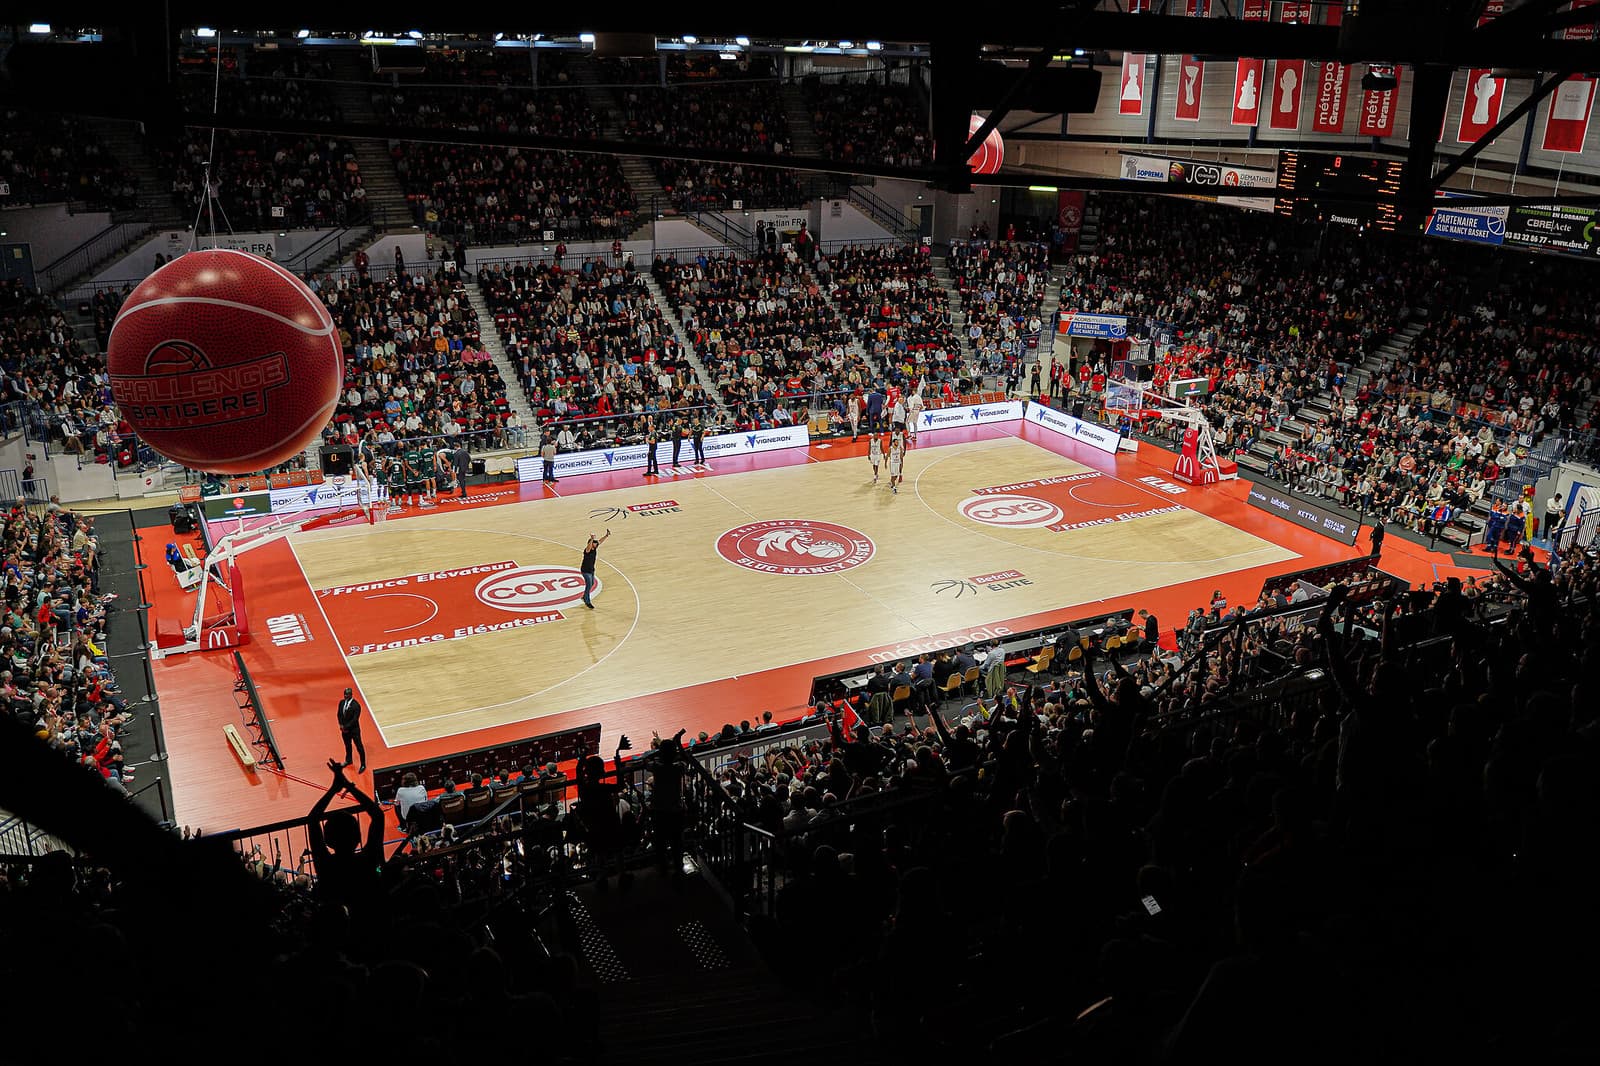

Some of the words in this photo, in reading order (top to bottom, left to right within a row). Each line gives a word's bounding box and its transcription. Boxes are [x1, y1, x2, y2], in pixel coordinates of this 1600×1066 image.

[1137, 169, 1163, 178] SOPREMA
[1185, 164, 1219, 185] JCD
[1437, 214, 1479, 228] PARTENAIRE
[1467, 229, 1489, 238] BASKET
[252, 243, 274, 253] FRA
[112, 360, 284, 403] CHALLENGE
[132, 391, 259, 420] BATIGERE
[933, 415, 964, 424] VIGNERON
[980, 409, 1009, 418] VIGNERON
[756, 435, 791, 445] VIGNERON
[1079, 428, 1105, 443] VIGNERON
[986, 481, 1037, 493] France
[440, 490, 515, 503] Automotors
[459, 496, 499, 505] Nancy
[632, 501, 674, 511] Betclic
[973, 500, 1050, 520] cora
[1297, 509, 1319, 523] KETTAL
[1062, 517, 1115, 530] France
[737, 557, 778, 573] SLUC
[782, 562, 846, 574] NANCY
[846, 538, 871, 565] BASKET
[333, 578, 409, 596] France
[416, 562, 513, 583] Elévateur
[976, 570, 1019, 583] Betclic
[487, 576, 585, 600] cora
[363, 633, 444, 652] France
[453, 613, 559, 637] Elévateur
[868, 625, 1014, 664] métropole
